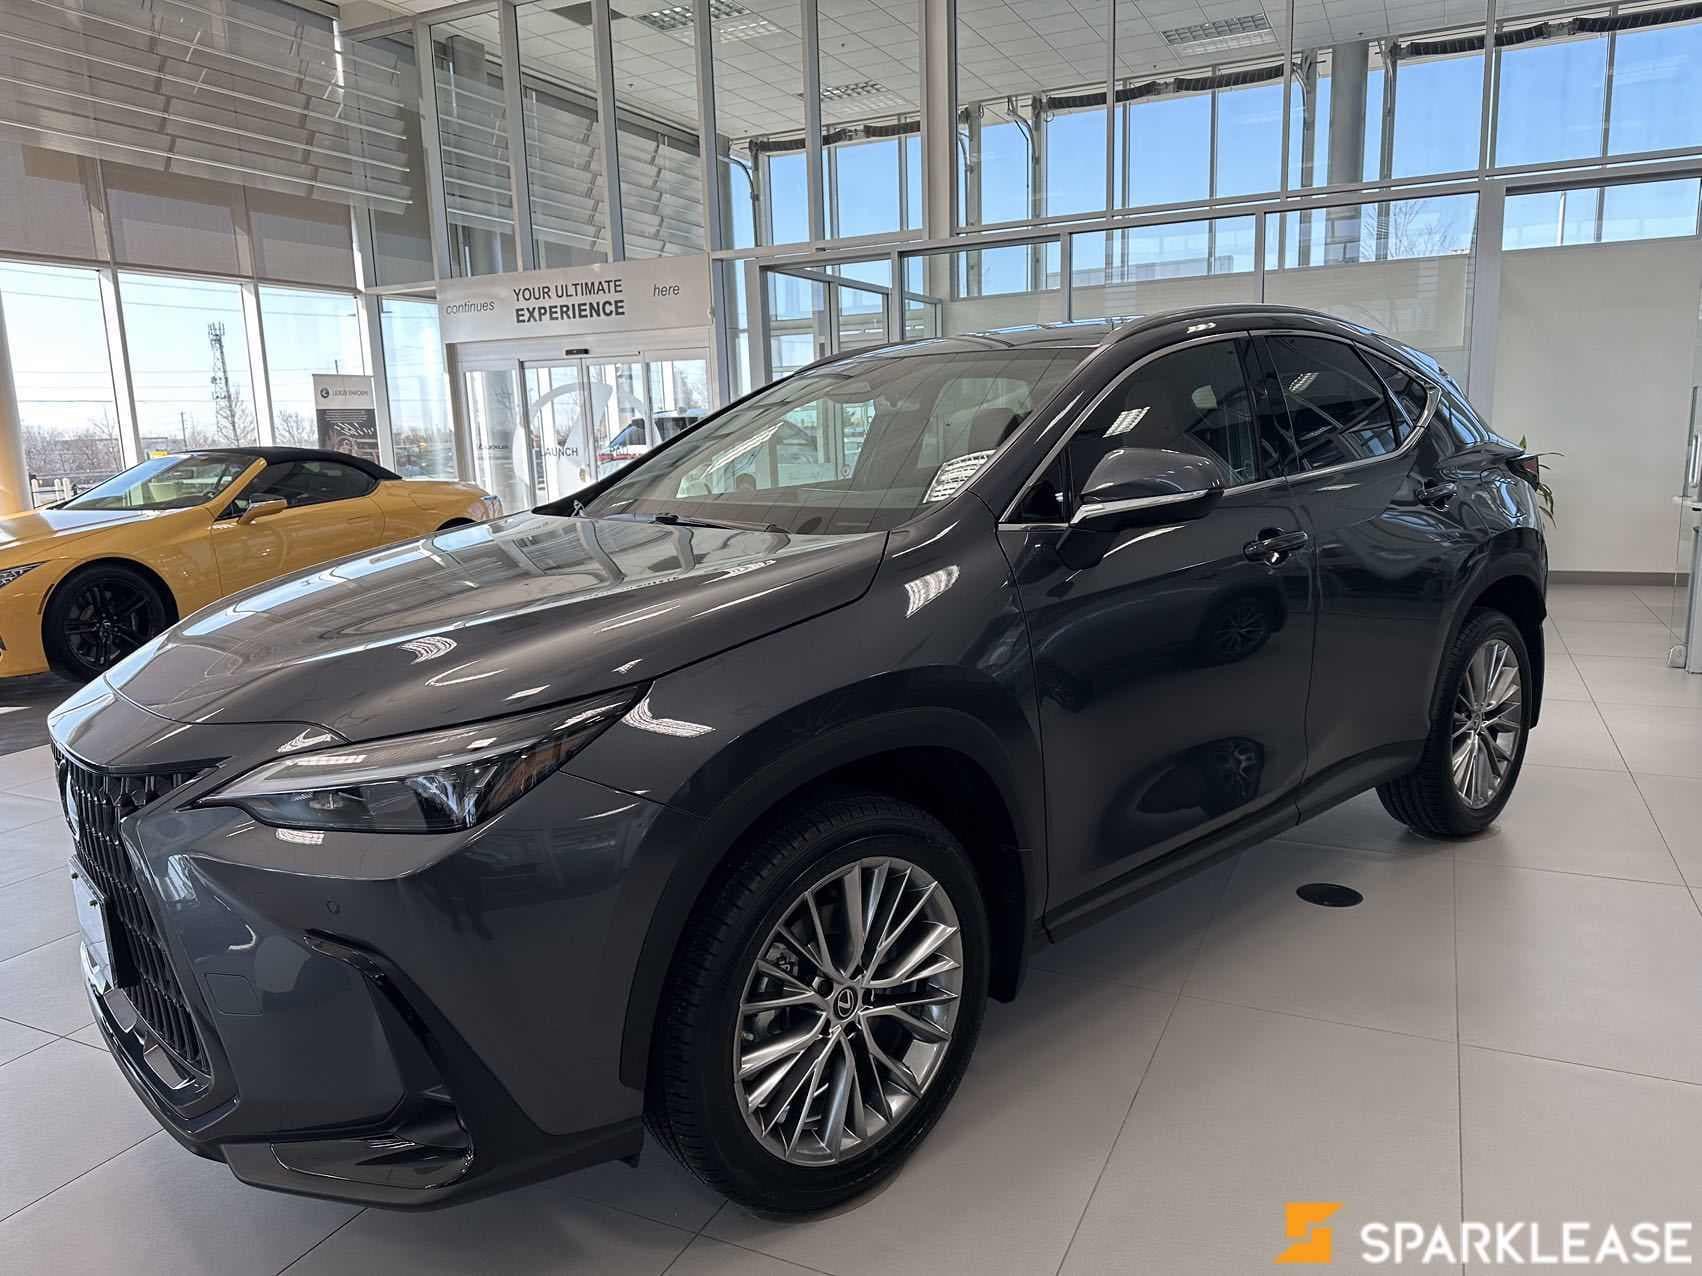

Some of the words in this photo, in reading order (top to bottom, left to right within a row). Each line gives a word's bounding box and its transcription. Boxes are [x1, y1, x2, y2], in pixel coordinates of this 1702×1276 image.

[513, 284, 552, 303] YOUR
[554, 279, 623, 299] ULTIMATE
[652, 284, 680, 297] here
[445, 300, 496, 315] continues
[515, 299, 626, 324] EXPERIENCE
[539, 447, 579, 457] LAUNCH
